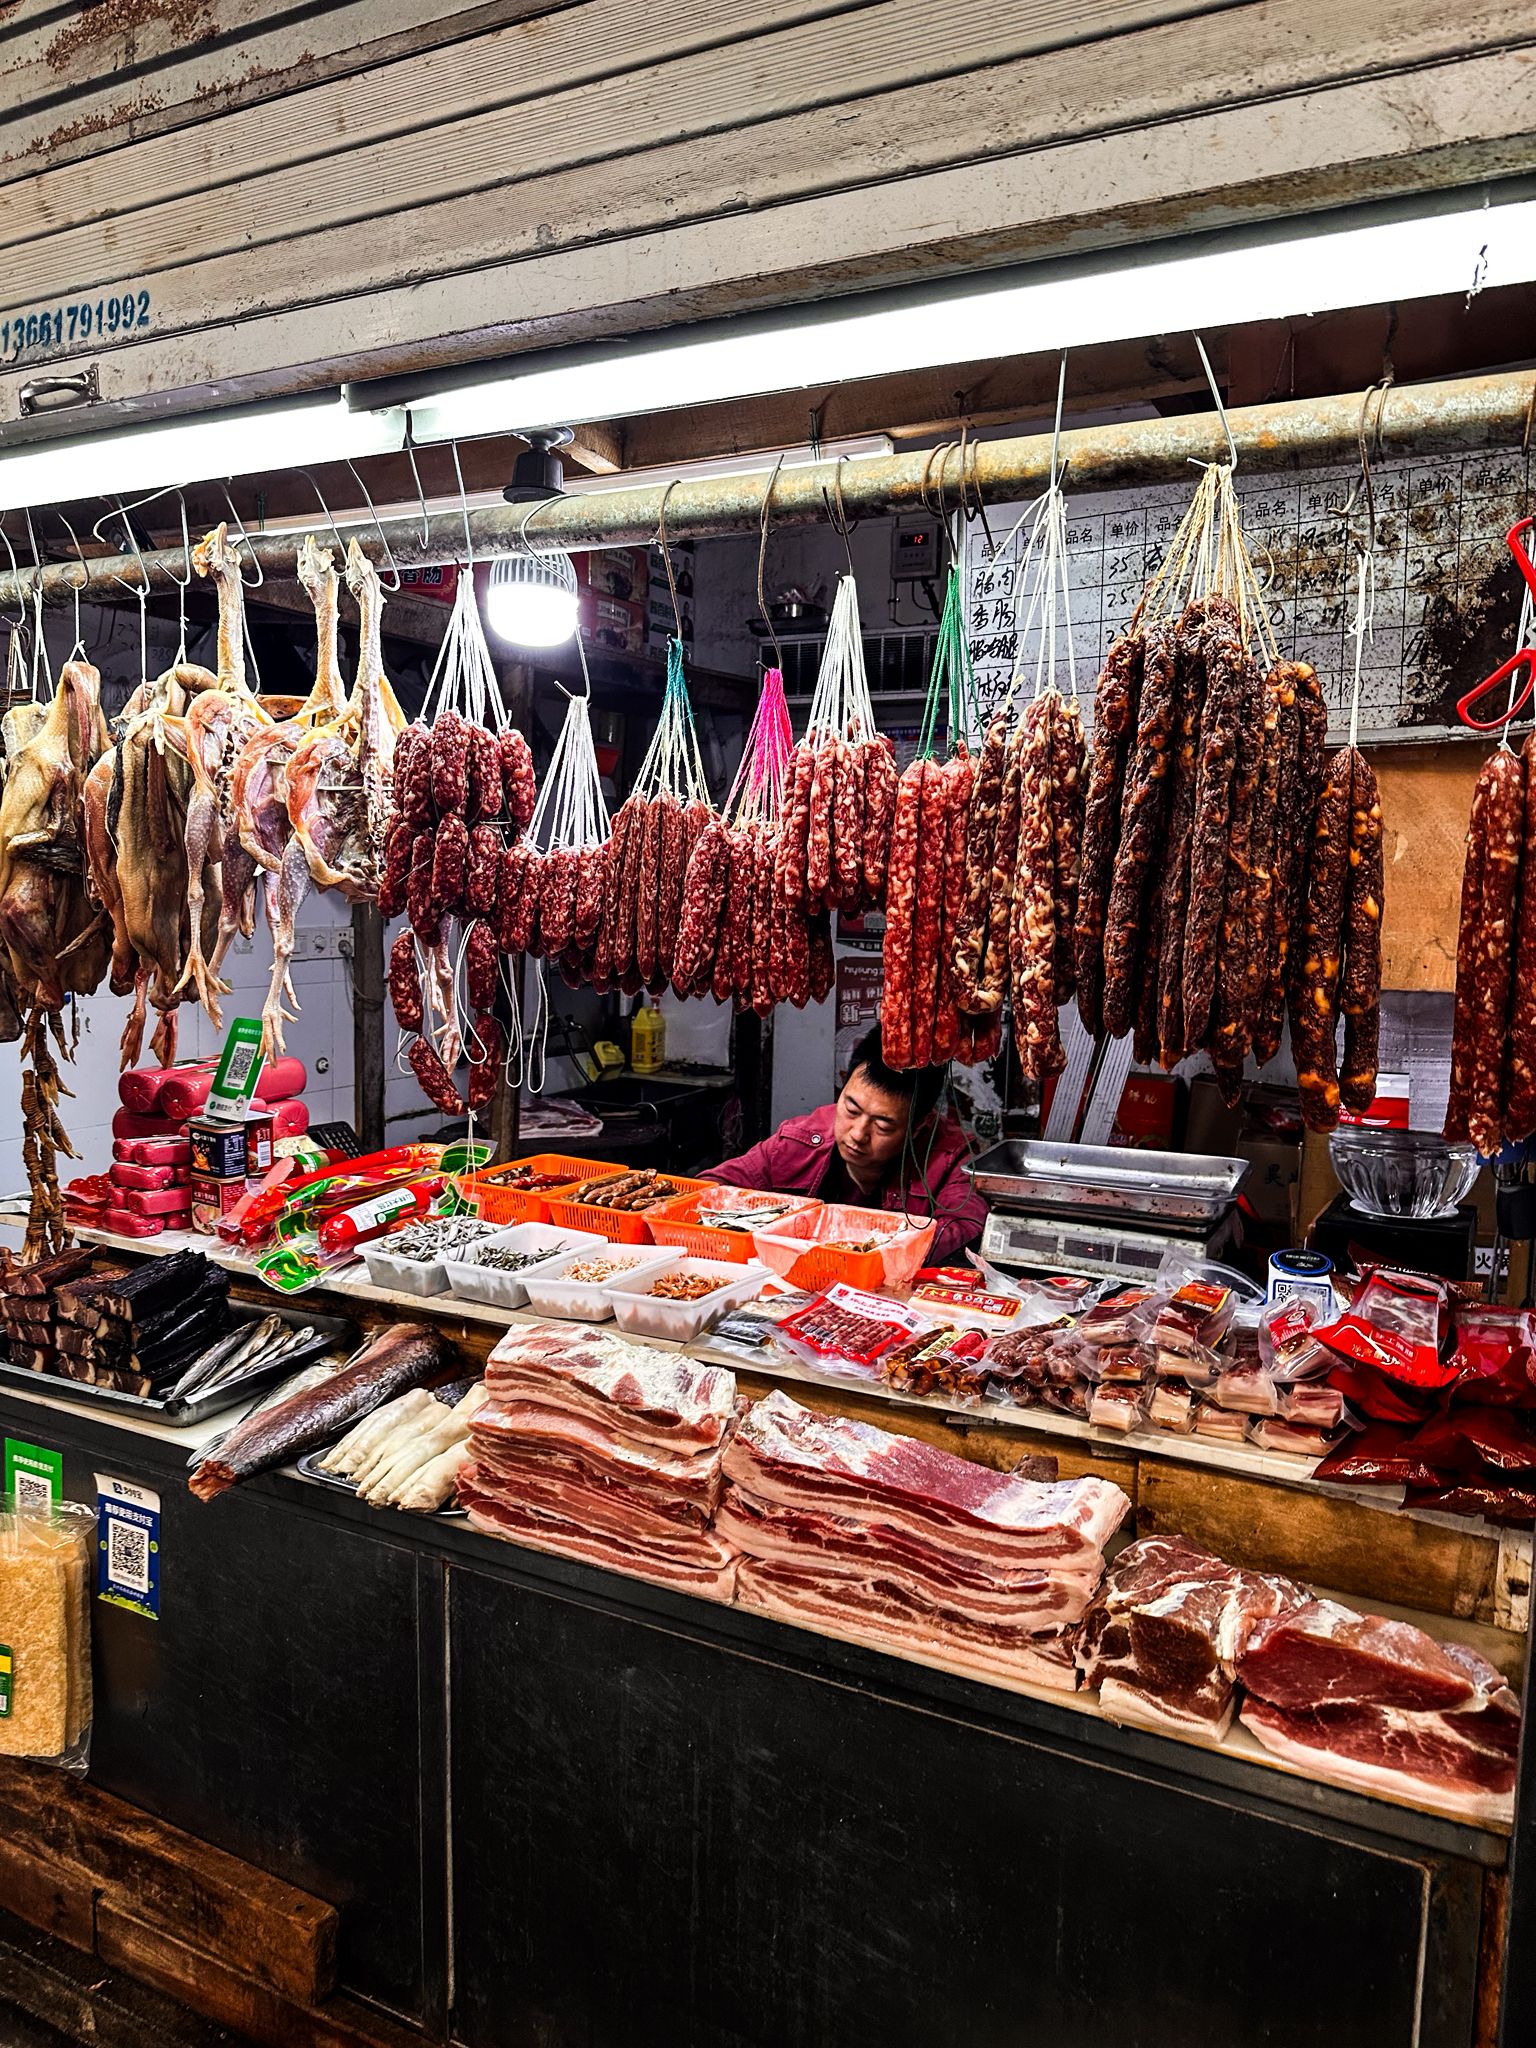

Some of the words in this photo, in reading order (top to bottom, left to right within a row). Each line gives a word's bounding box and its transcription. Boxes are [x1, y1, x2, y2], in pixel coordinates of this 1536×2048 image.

[2, 290, 150, 351] 13661791992
[1418, 475, 1453, 494] 单价
[1255, 499, 1287, 518] 品名
[1307, 491, 1341, 511] 单价
[914, 534, 923, 544] 12
[1065, 527, 1093, 545] 品名
[1110, 521, 1139, 538] 单价
